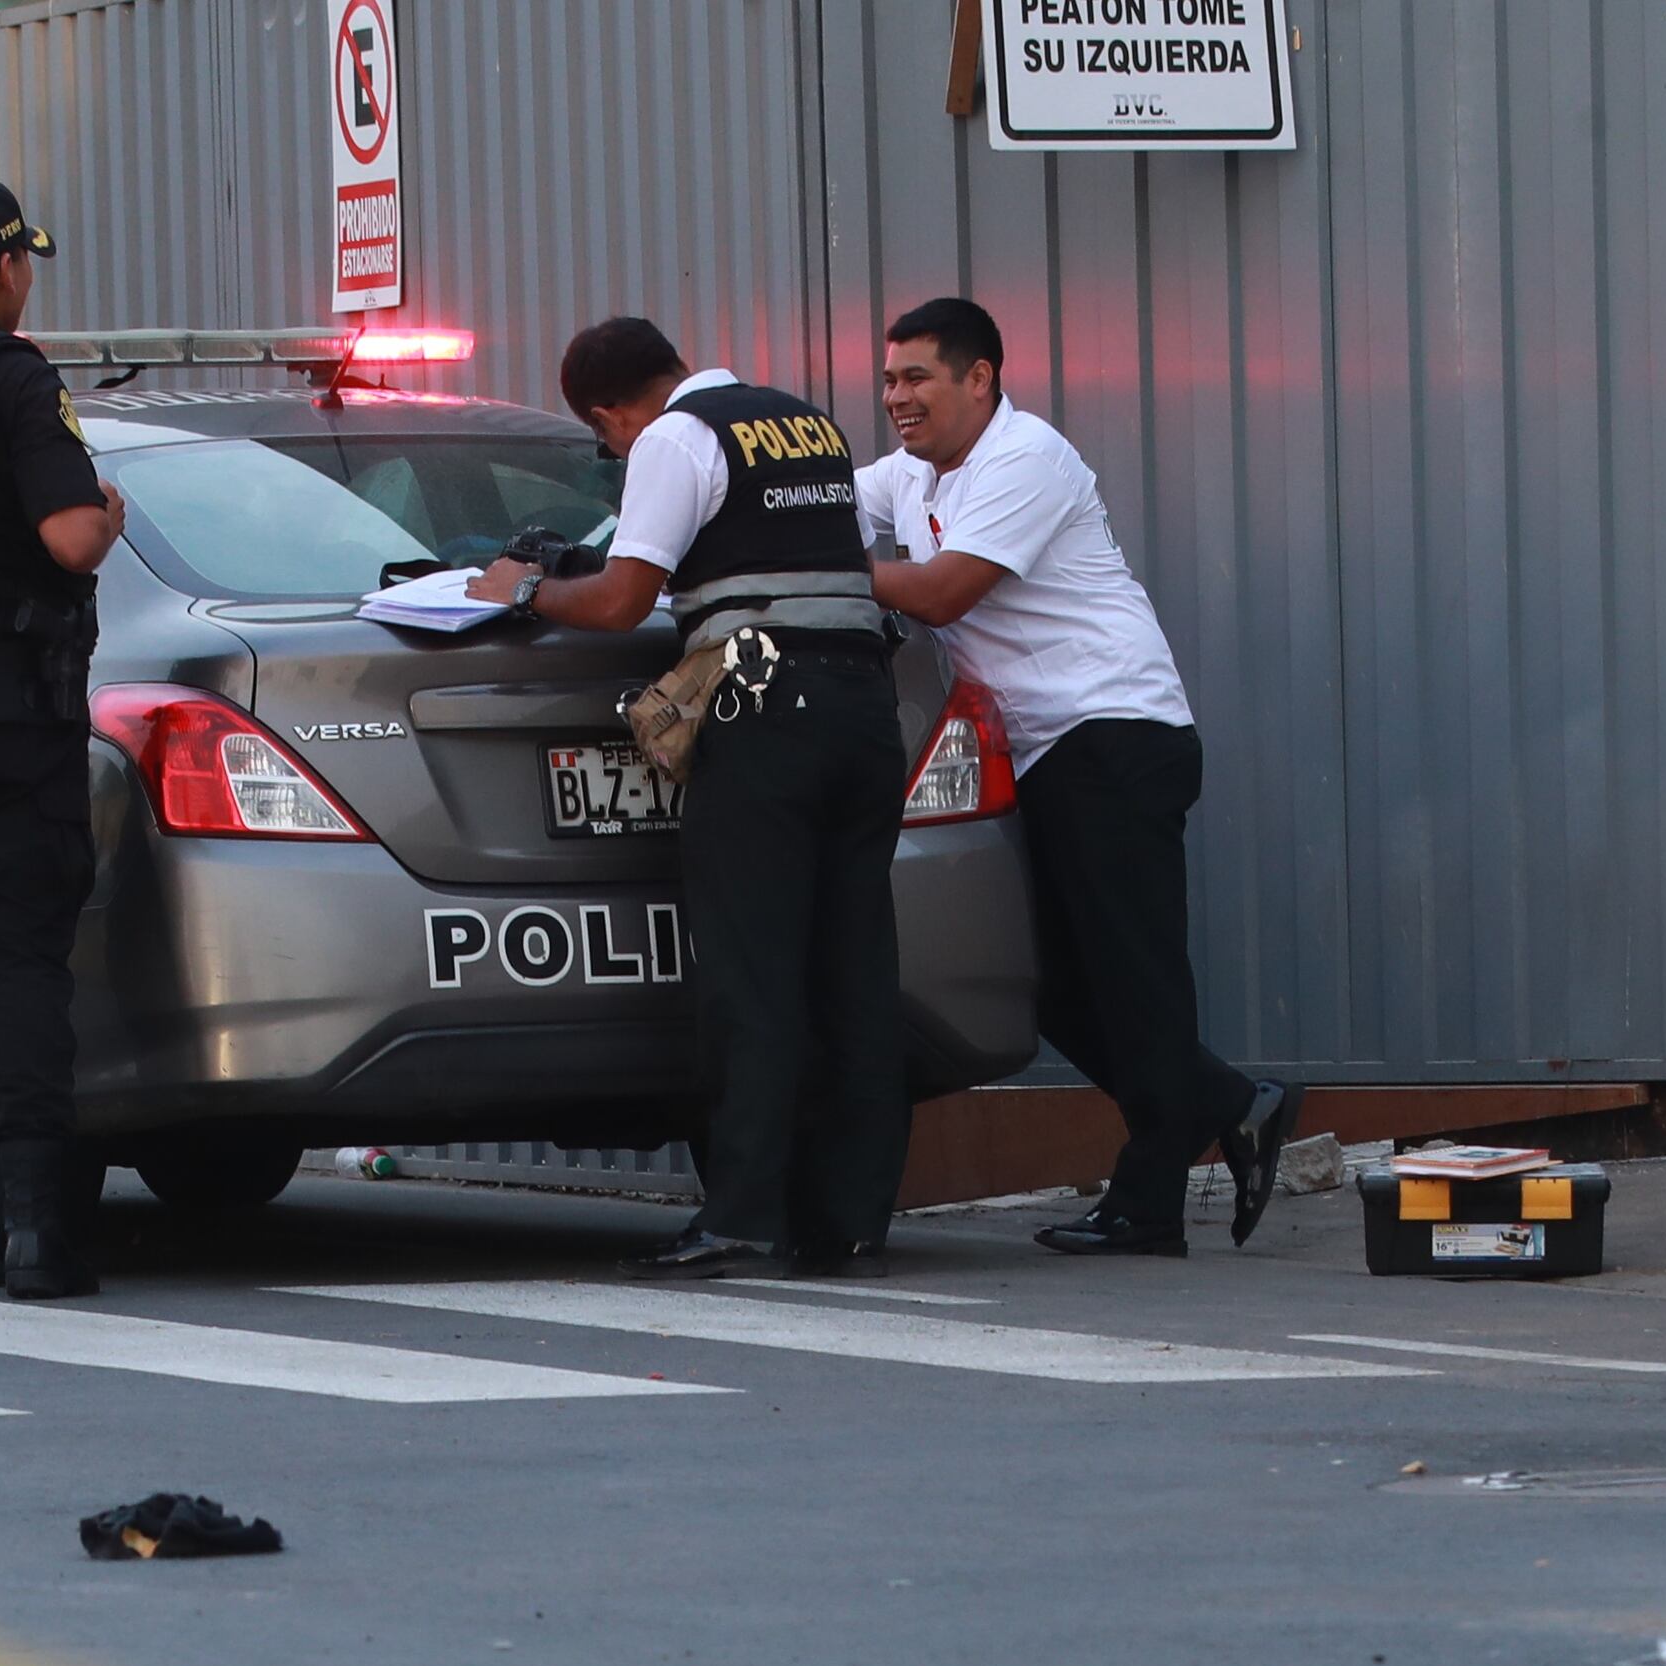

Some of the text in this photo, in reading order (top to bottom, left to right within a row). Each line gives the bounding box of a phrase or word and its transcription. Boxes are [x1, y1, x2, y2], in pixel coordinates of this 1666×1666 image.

[1021, 0, 1246, 25] PEATON TOME
[1023, 39, 1251, 75] SU IZQUIERDA
[339, 193, 396, 243] PROHIBIDO
[342, 244, 394, 279] ESTACIONARSE
[292, 721, 406, 742] VERSA
[601, 749, 646, 767] PER
[423, 903, 698, 989] POLI
